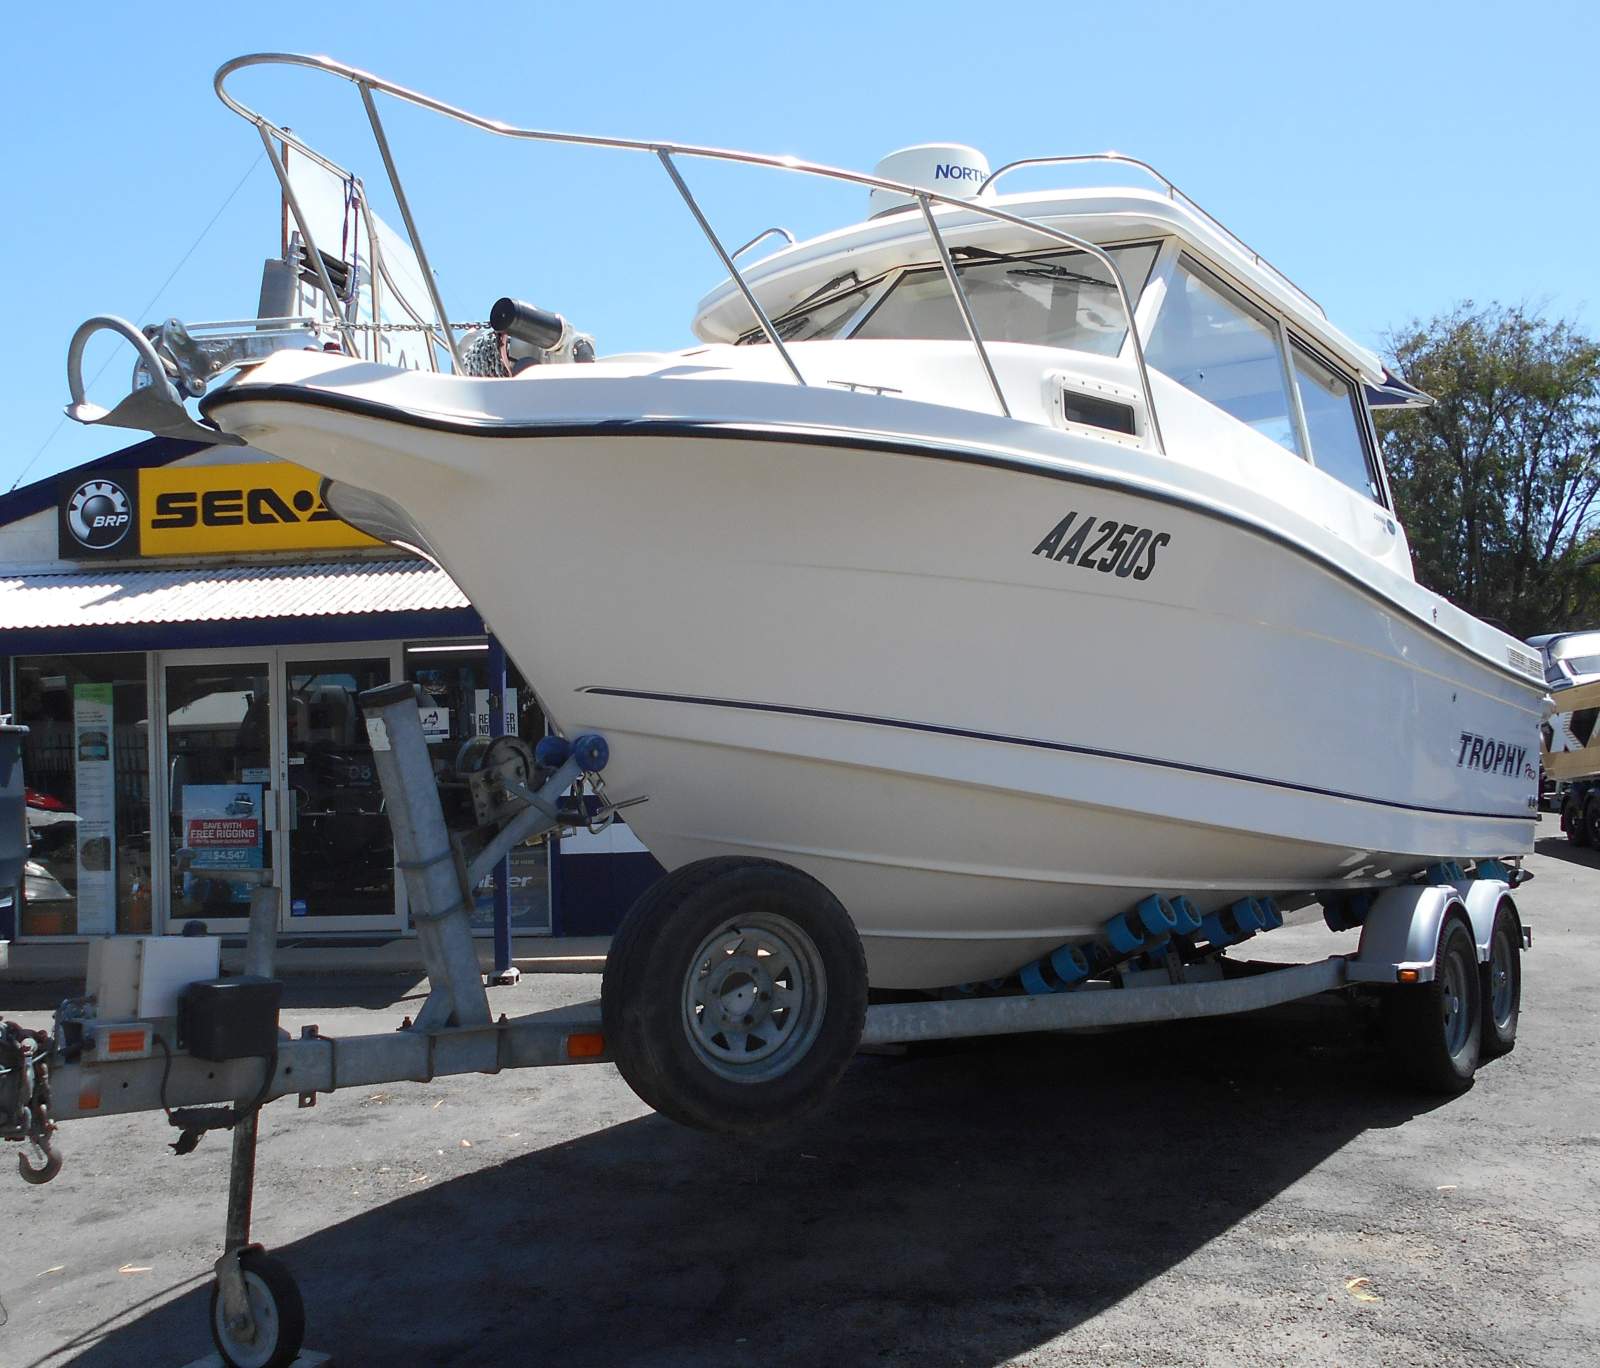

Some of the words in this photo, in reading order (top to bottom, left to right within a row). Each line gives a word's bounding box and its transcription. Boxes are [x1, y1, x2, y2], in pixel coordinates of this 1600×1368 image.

[935, 164, 988, 182] NORTH
[92, 513, 129, 528] BRP
[1032, 511, 1171, 581] AA250S
[1457, 731, 1527, 778] TROPHY
[191, 830, 215, 838] FREE
[216, 829, 255, 838] RIGGING
[203, 822, 223, 830] SAVE
[223, 821, 242, 829] WITH
